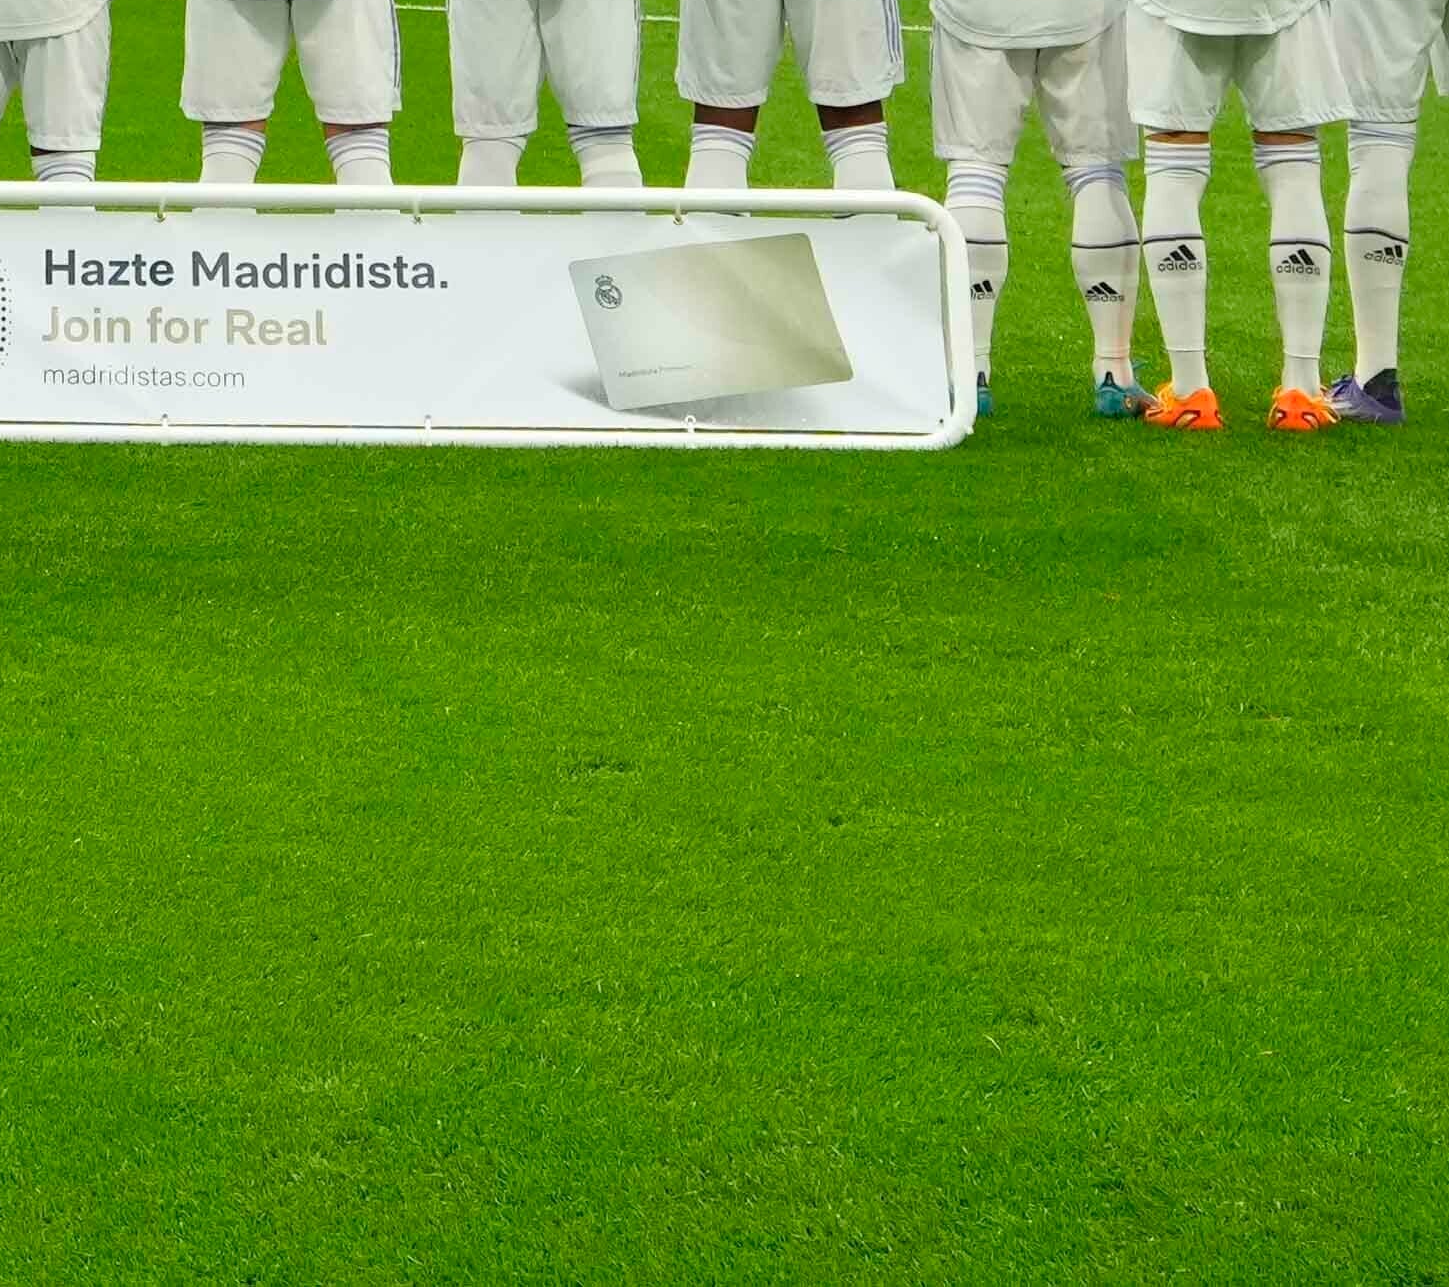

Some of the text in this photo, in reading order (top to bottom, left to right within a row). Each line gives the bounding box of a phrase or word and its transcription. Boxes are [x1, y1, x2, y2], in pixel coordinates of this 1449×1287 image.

[1158, 261, 1204, 272] adidas
[1363, 251, 1406, 266] adidas
[44, 249, 449, 289] Hazte Madridista.
[1276, 263, 1321, 275] adidas
[42, 306, 328, 346] Join for Real
[43, 365, 246, 388] madridistas.com
